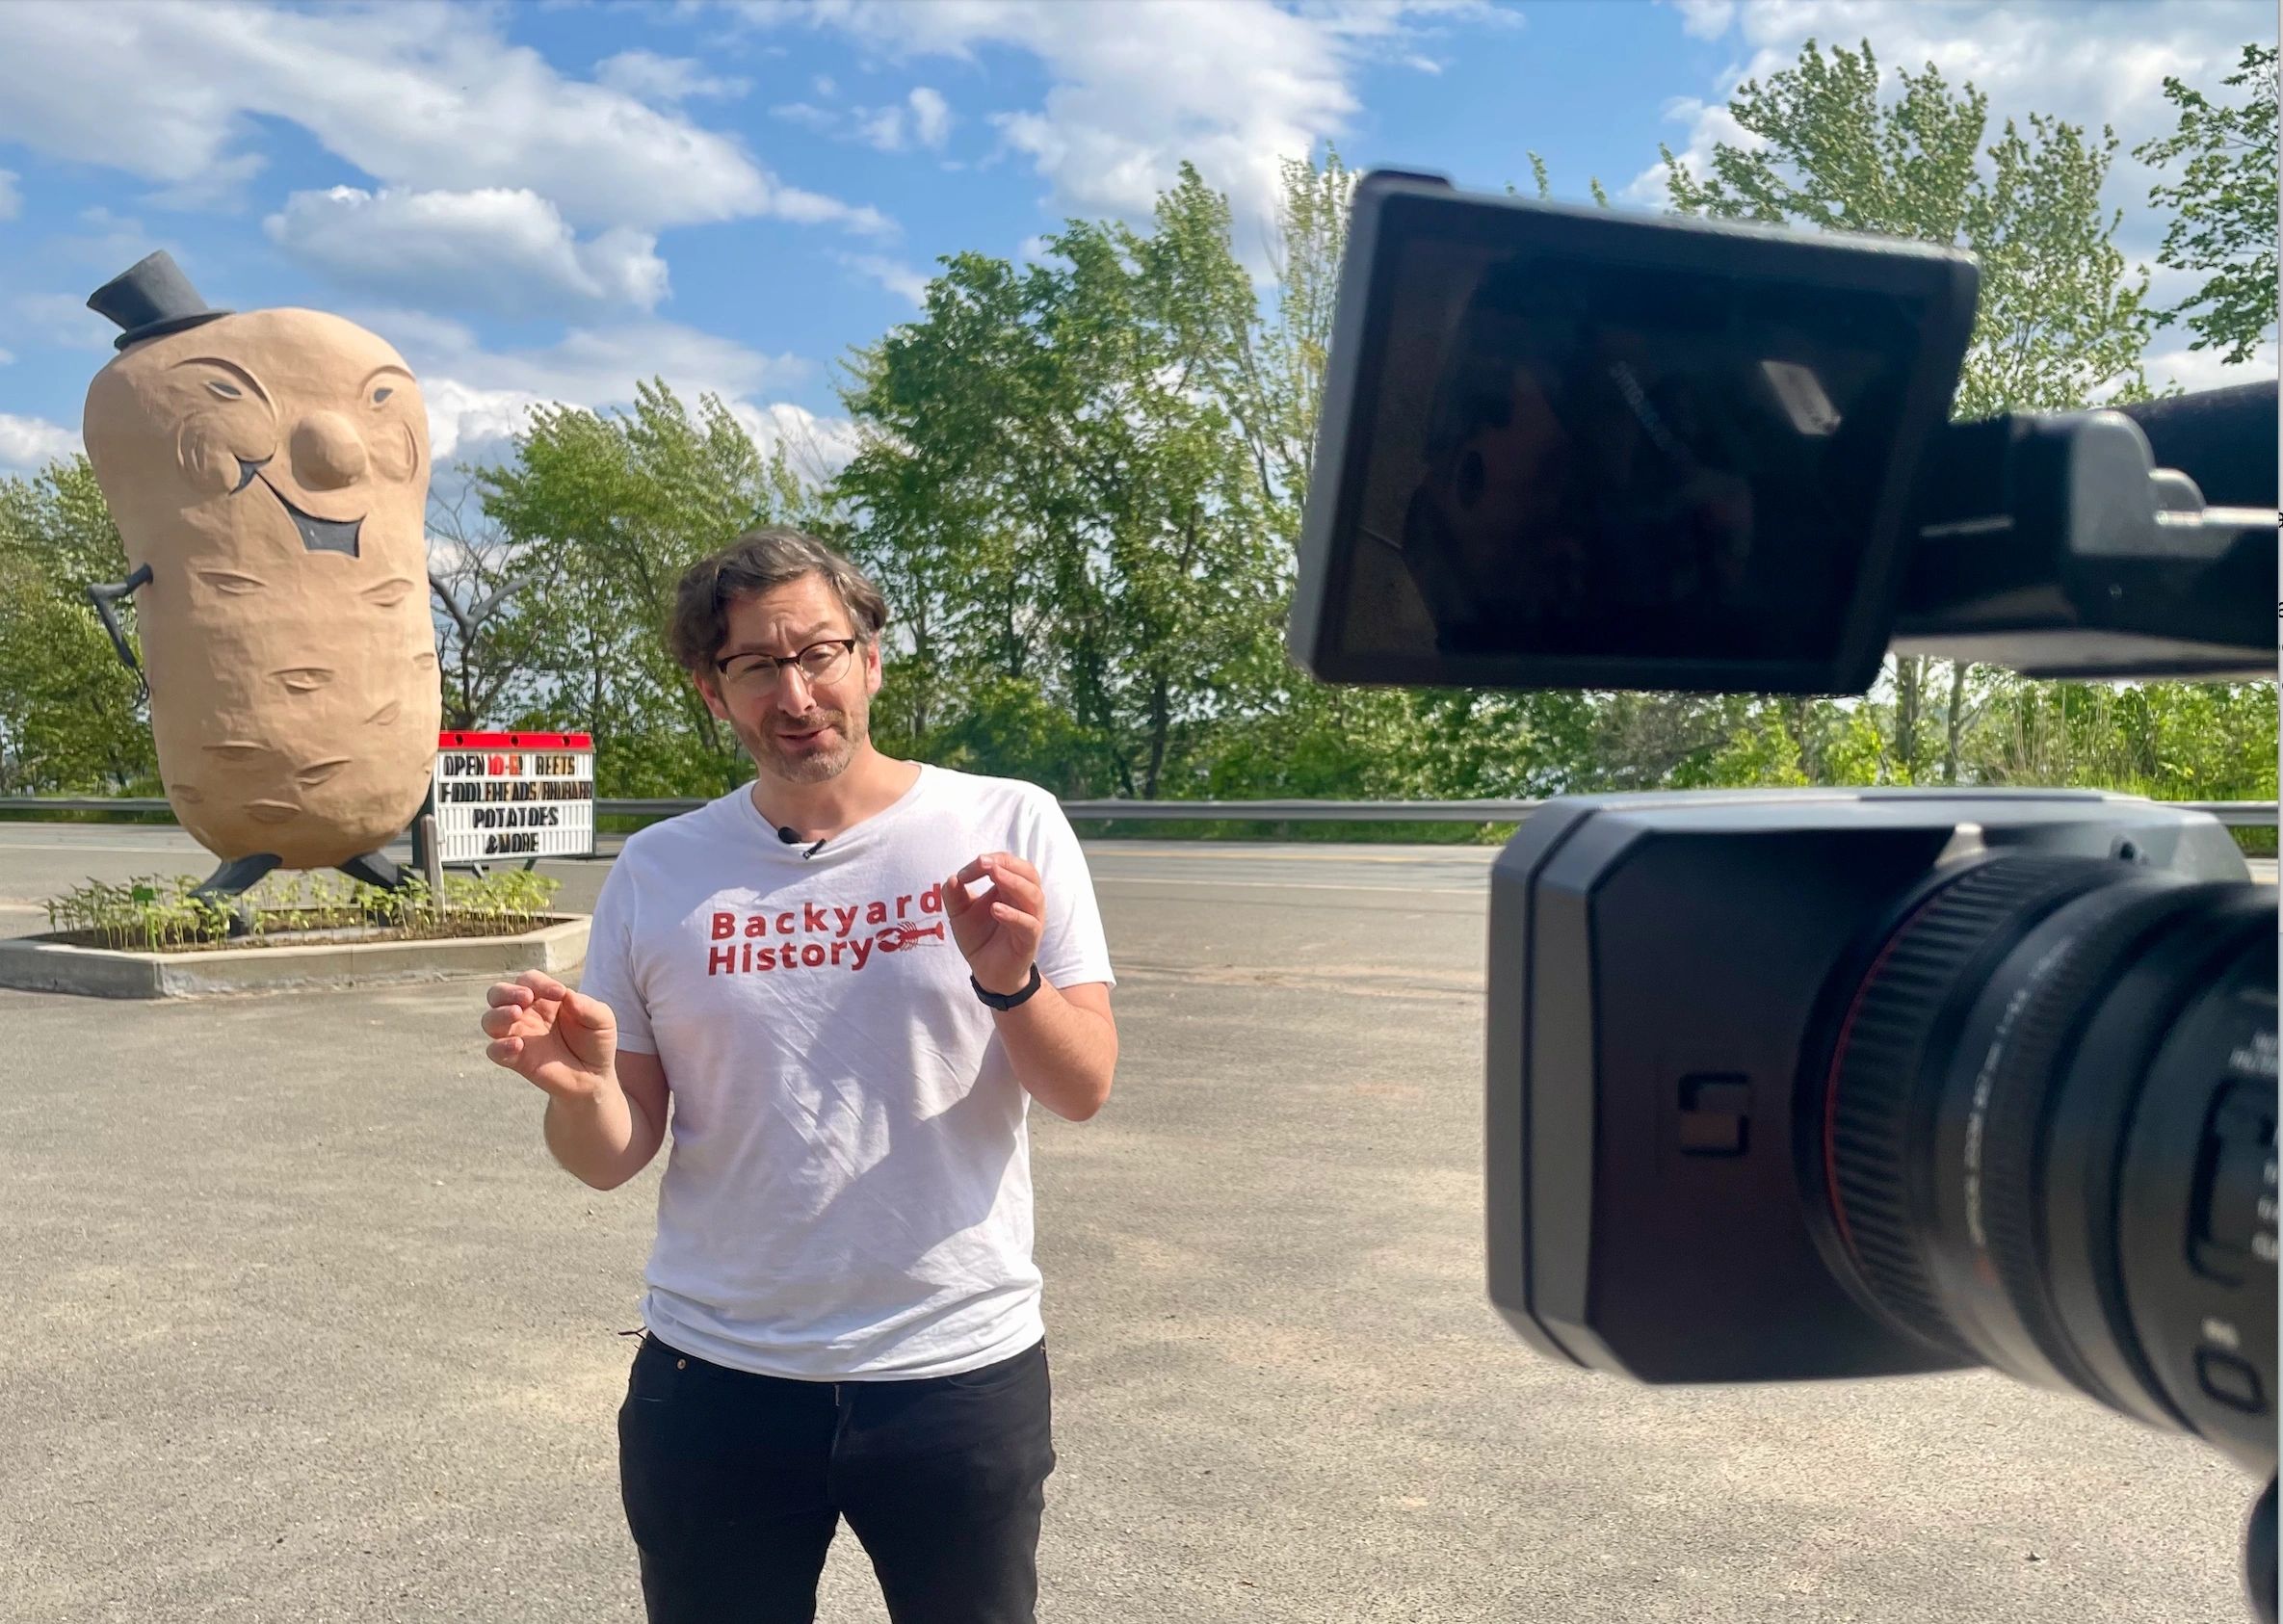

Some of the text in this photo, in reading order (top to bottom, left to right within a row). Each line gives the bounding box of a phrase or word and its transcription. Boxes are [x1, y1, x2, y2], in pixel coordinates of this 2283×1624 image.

[443, 755, 485, 776] OPEN
[473, 807, 559, 828] POTATOES
[711, 883, 942, 940] Backyard
[708, 937, 874, 976] History
